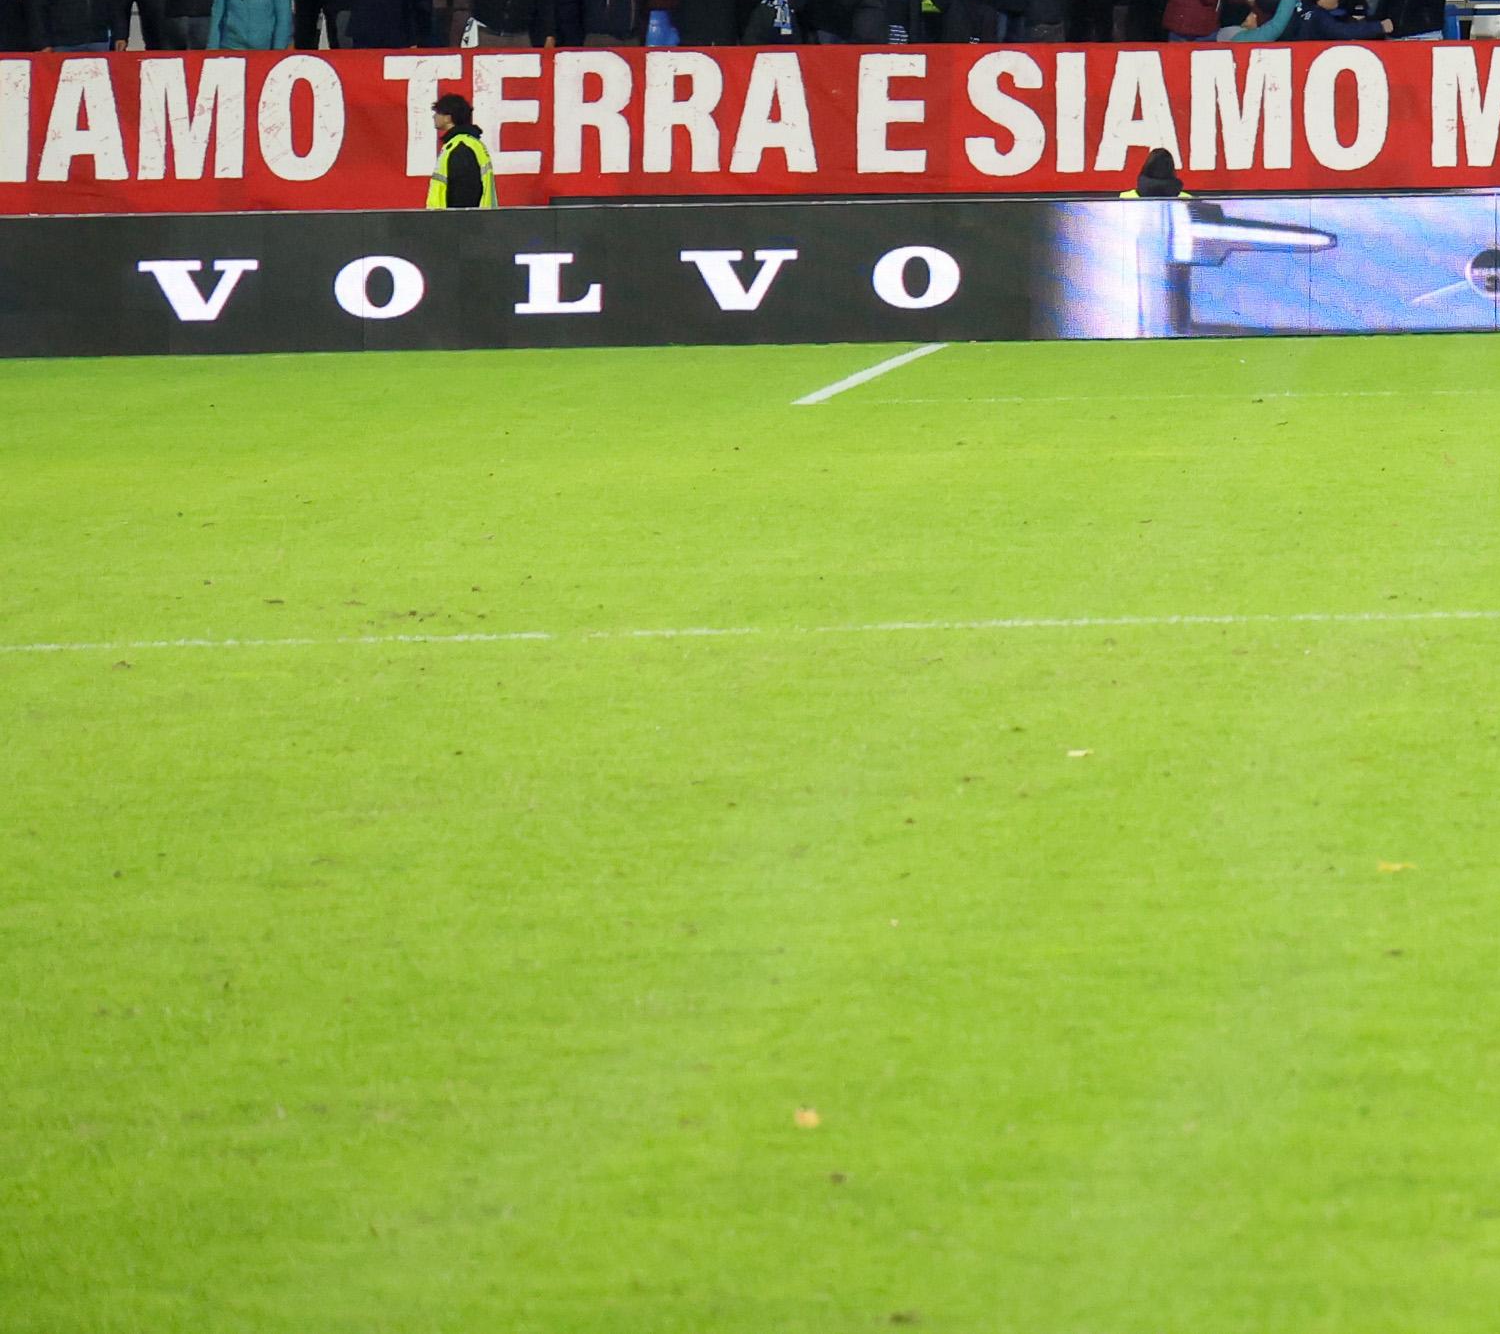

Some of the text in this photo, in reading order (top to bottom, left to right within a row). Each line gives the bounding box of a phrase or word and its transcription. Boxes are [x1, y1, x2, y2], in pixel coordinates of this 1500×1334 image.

[383, 50, 818, 178] TERRA
[857, 51, 928, 176] E
[965, 46, 1388, 177] SIAMO
[138, 245, 963, 322] VOLVO
